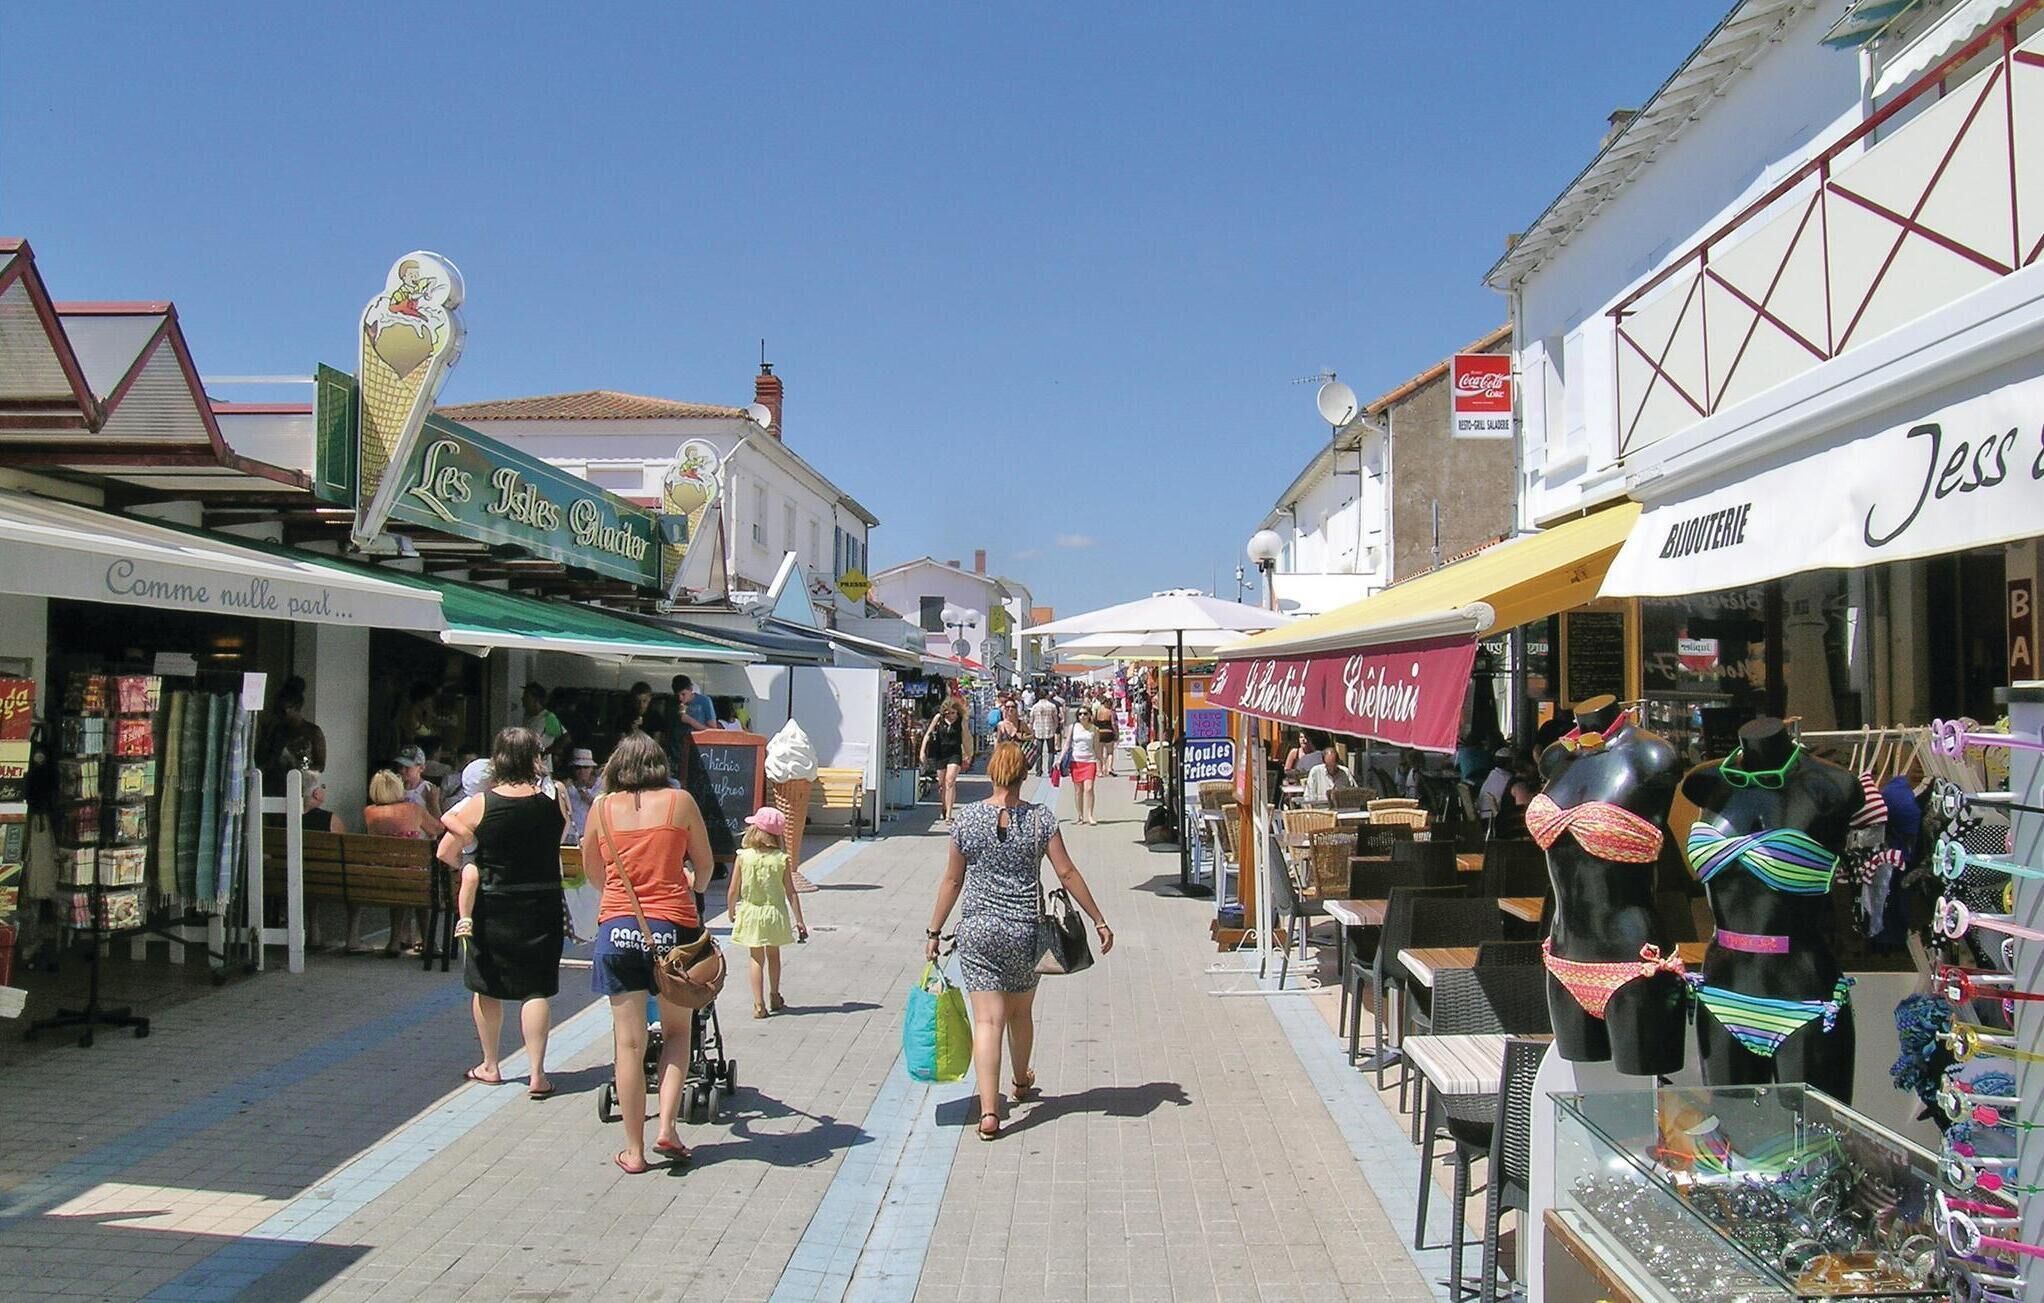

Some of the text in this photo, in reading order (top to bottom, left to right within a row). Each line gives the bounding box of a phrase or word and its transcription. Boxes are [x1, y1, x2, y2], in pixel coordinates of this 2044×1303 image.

[410, 440, 650, 561] Les Isles Glacier
[1864, 423, 2018, 548] Jess
[1659, 503, 1752, 558] BIJOUTERIE
[105, 559, 210, 603] Comme
[220, 577, 278, 610] nulle
[1184, 743, 1230, 763] Moules
[1184, 762, 1217, 780] Frites
